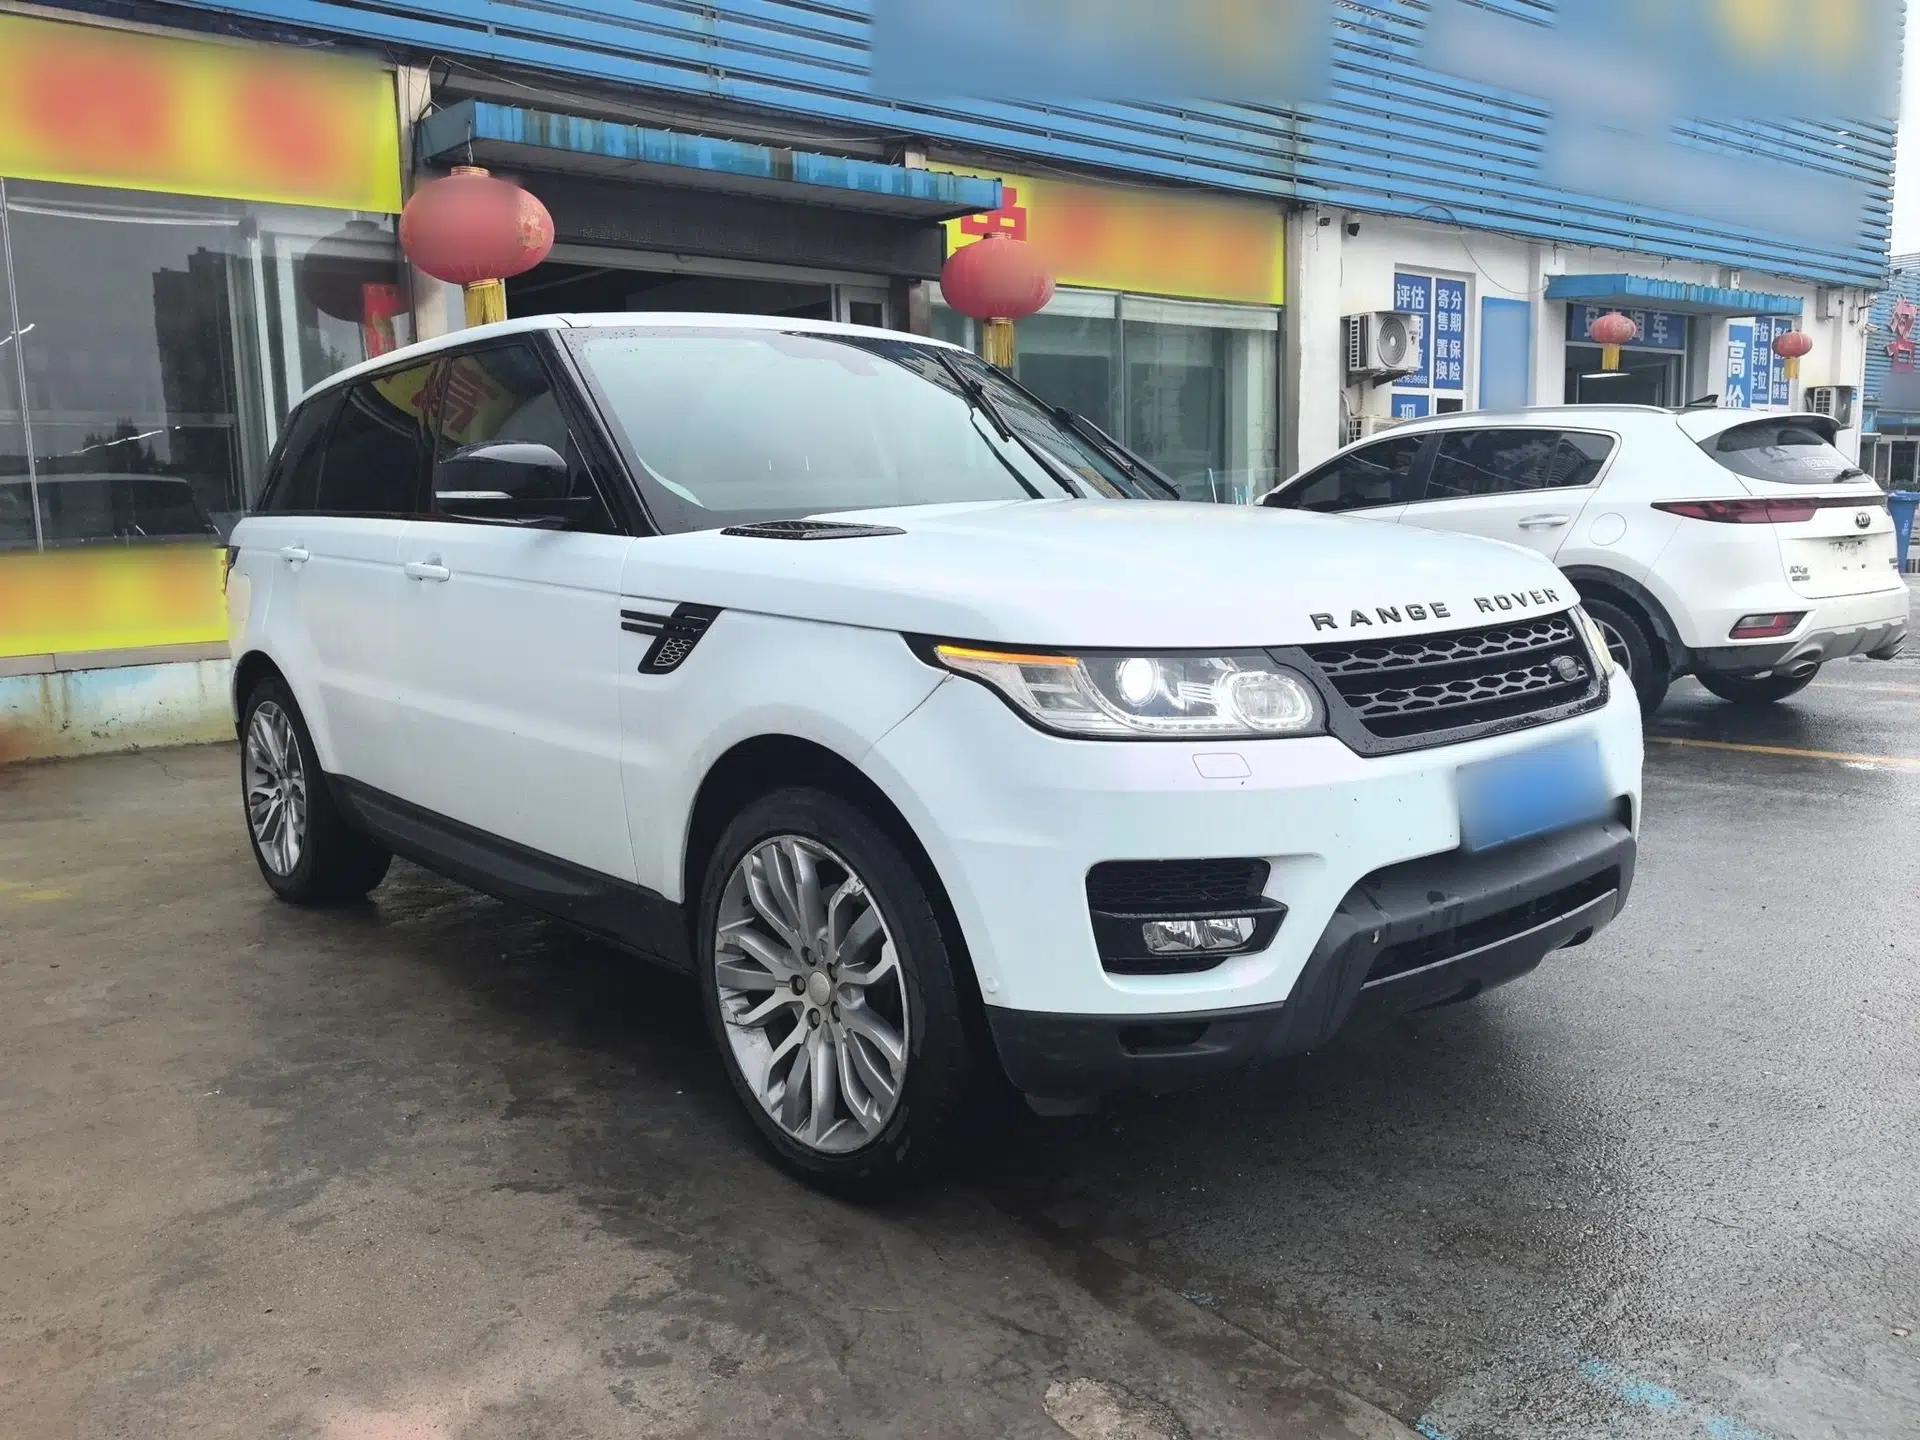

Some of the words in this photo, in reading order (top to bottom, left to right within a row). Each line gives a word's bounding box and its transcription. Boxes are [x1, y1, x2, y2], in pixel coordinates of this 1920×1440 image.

[1397, 284, 1424, 309] 评估
[1727, 340, 1746, 407] 高价
[1310, 601, 1450, 631] RANGE
[1474, 587, 1560, 613] ROVER
